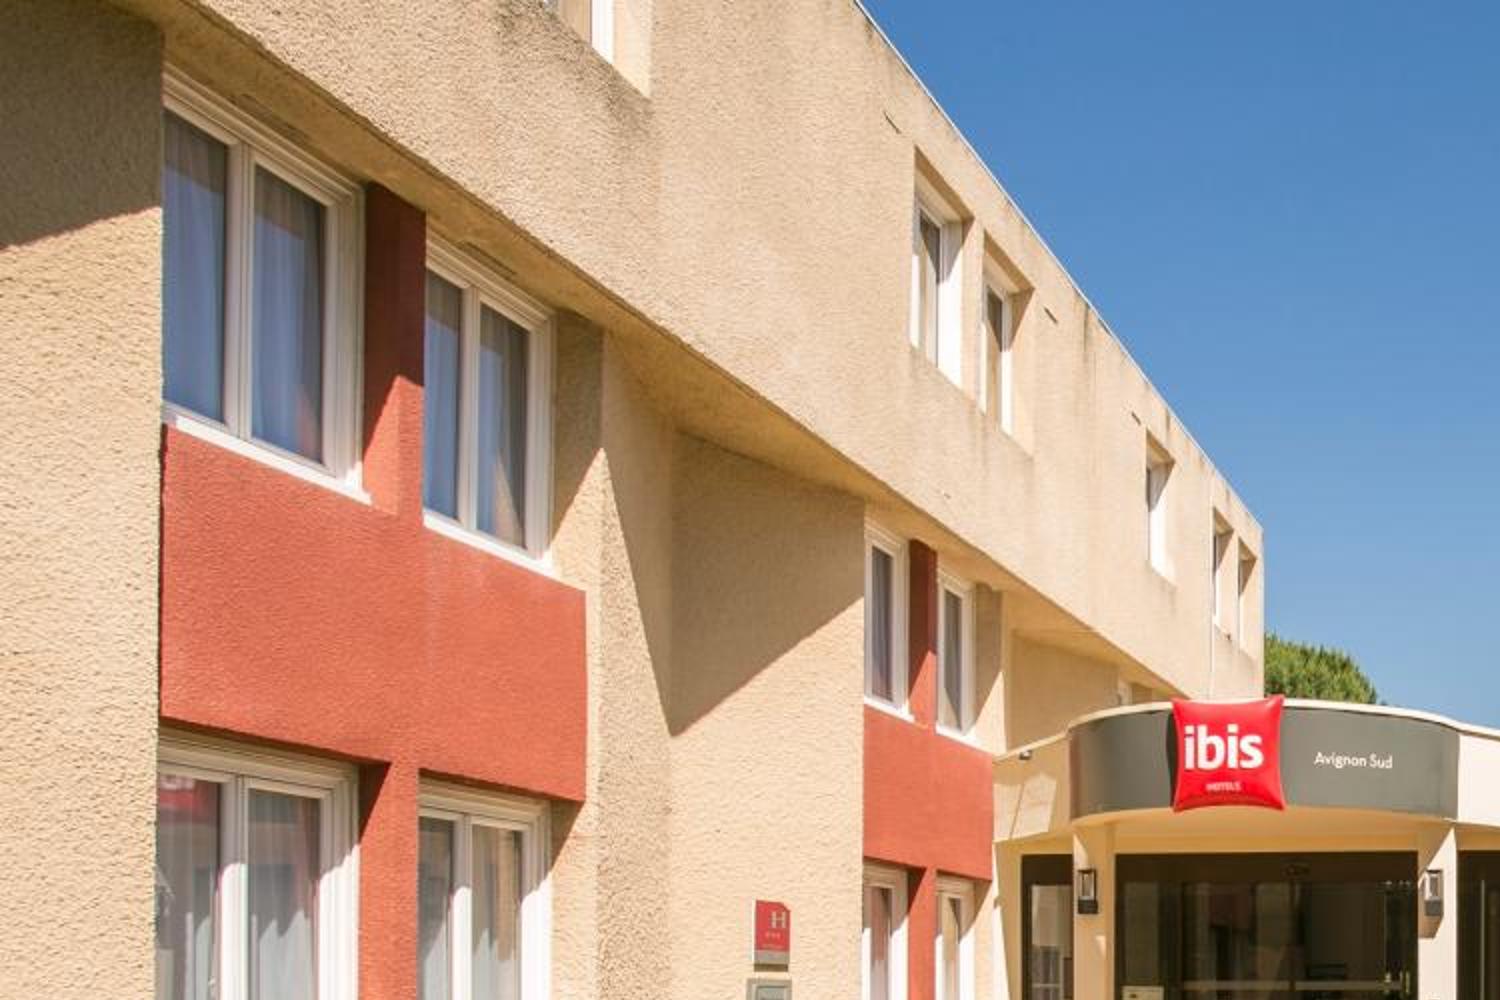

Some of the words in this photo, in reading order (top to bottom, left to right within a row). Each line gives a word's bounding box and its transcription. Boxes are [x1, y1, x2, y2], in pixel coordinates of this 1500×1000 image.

[1184, 723, 1264, 770] ibis
[1314, 752, 1367, 769] Avignon
[1369, 753, 1393, 769] Sud
[771, 911, 787, 929] H
